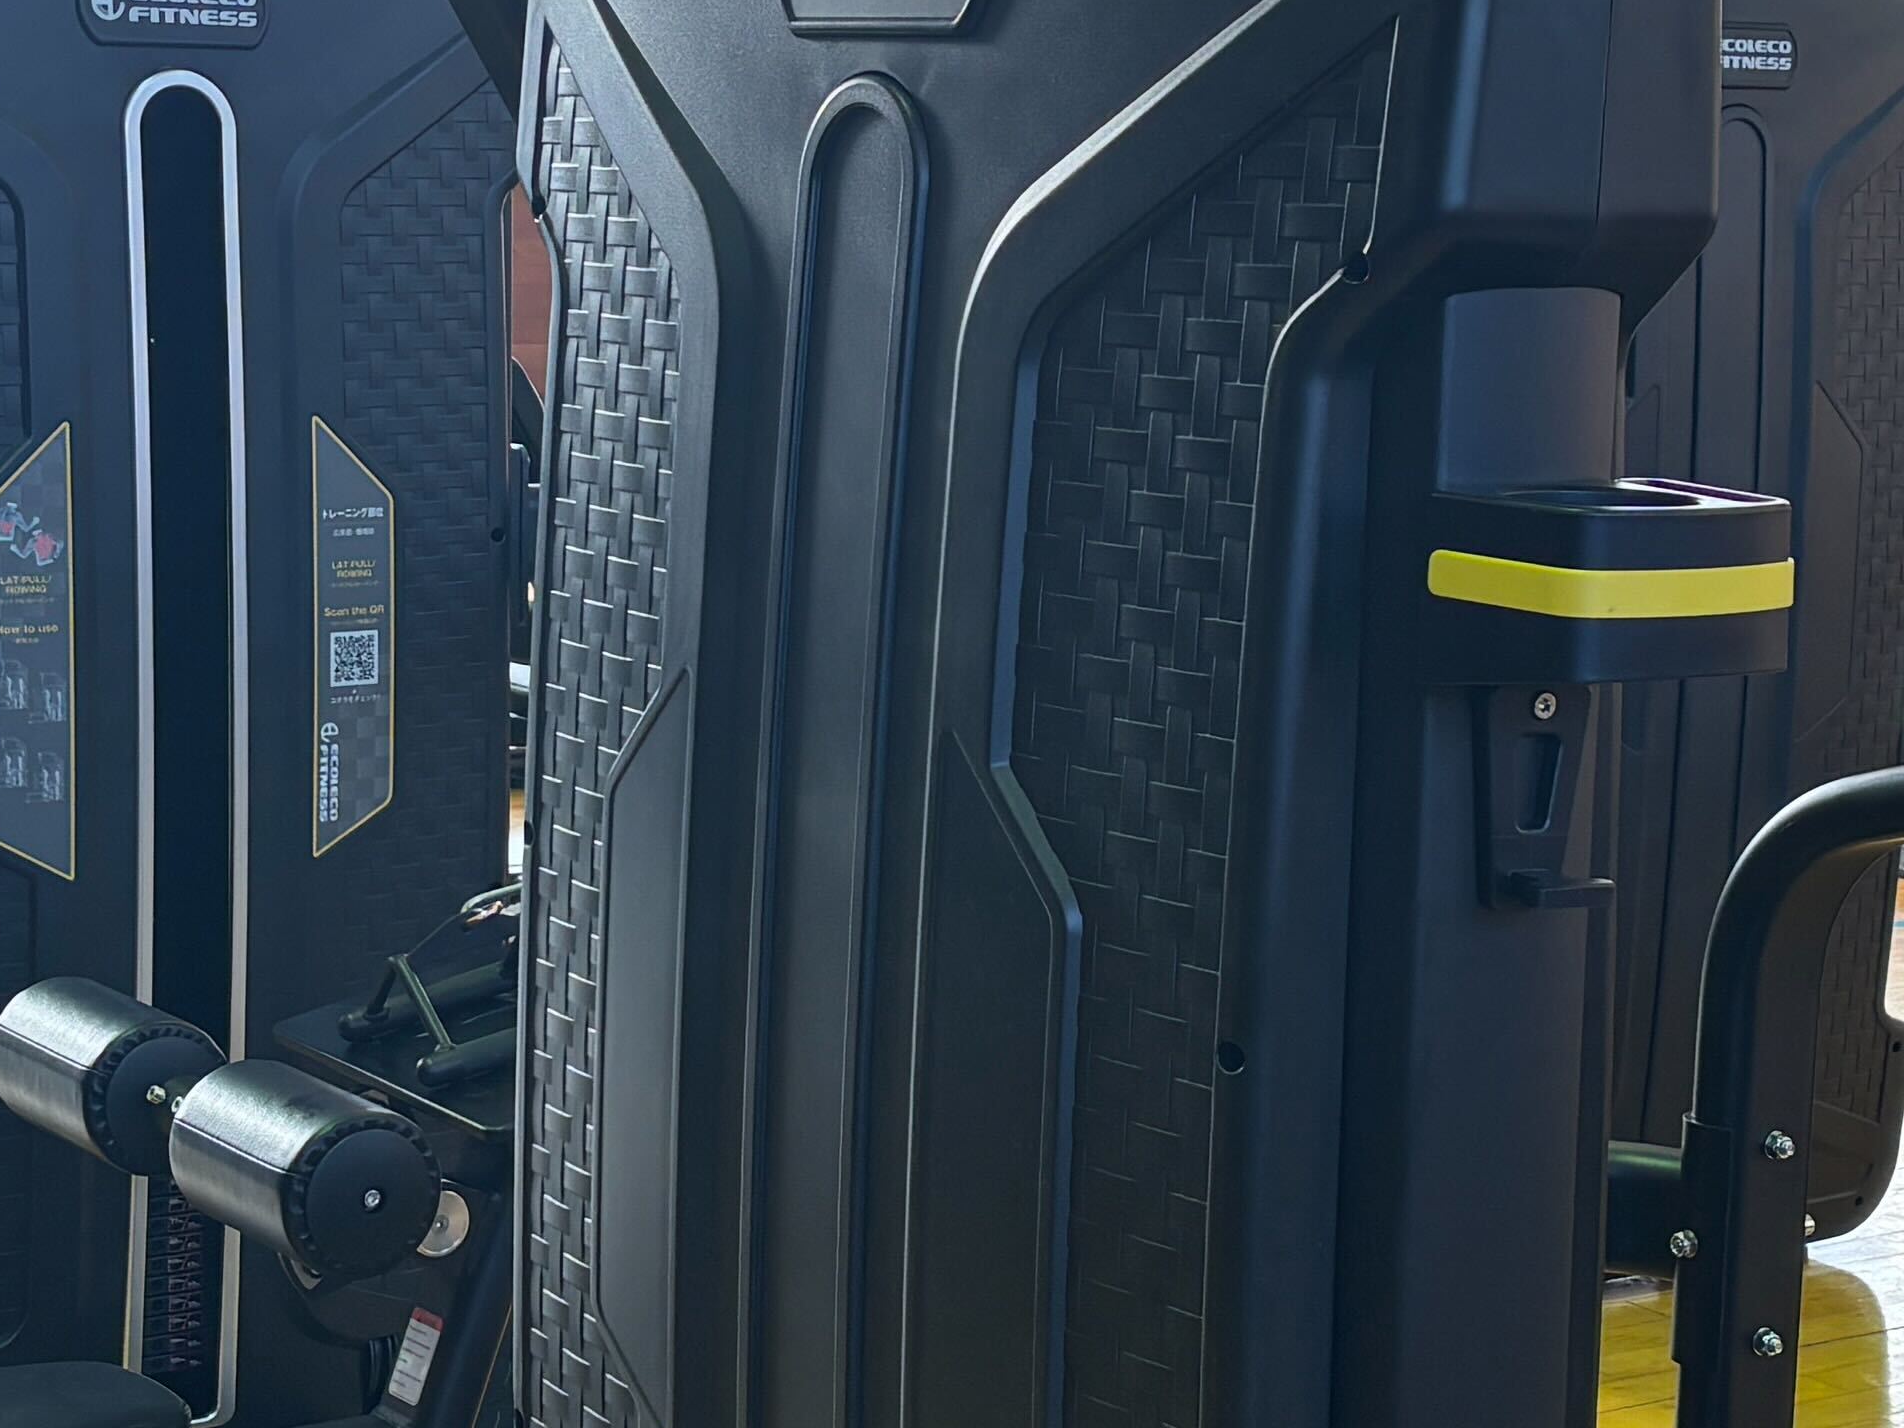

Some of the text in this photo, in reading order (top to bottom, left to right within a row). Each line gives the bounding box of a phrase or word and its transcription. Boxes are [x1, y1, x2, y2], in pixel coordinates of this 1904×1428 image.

[128, 6, 258, 28] FITNESS
[1720, 38, 1792, 54] COLECO
[24, 624, 36, 634] to
[319, 744, 328, 822] FITNESS
